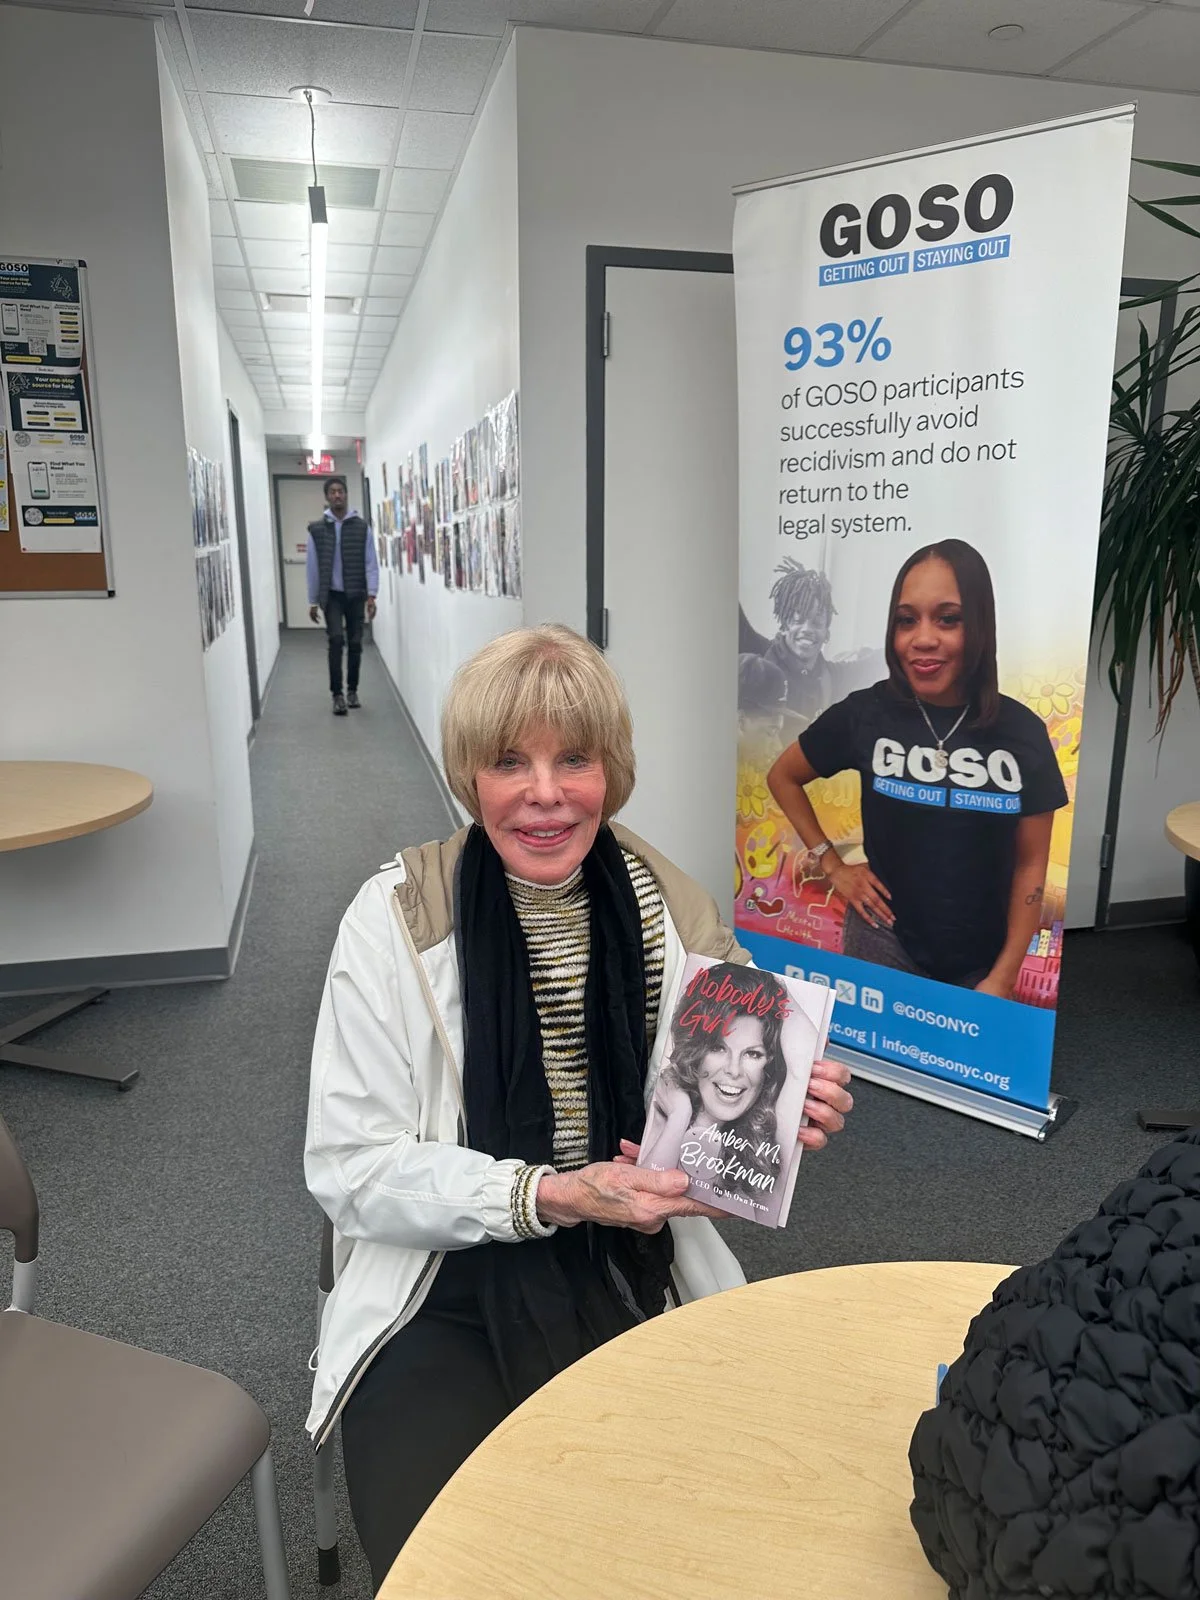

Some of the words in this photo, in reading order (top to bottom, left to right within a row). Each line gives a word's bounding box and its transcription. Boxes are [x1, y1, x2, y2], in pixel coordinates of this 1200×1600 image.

[819, 173, 1014, 259] GOSO
[823, 262, 875, 283] GETTING
[879, 256, 906, 274] OUT
[917, 245, 974, 268] STAYING
[978, 239, 1007, 257] OUT
[783, 316, 892, 371] 93%
[781, 387, 801, 410] of
[805, 380, 877, 408] GOSO
[883, 368, 1025, 406] participants
[780, 411, 911, 442] successfully
[916, 404, 979, 431] avoid
[780, 448, 885, 473] recidivism
[891, 442, 934, 467] and
[941, 441, 970, 463] do
[977, 439, 1017, 462] not
[779, 483, 842, 504] return
[848, 483, 868, 502] to
[873, 479, 909, 500] the
[778, 514, 825, 540] legal
[831, 514, 912, 538] system.
[872, 737, 1023, 793] GOSO
[875, 777, 915, 798] GETTING
[918, 788, 942, 802] OUT
[955, 792, 1002, 810] STAYING
[686, 967, 794, 1020] Nobody's
[679, 1000, 738, 1038] Girl
[893, 1001, 980, 1038] @GOSONYC
[882, 1035, 1011, 1091] info@gosonyc.org
[698, 1122, 754, 1152] Amber
[755, 1140, 780, 1165] M.
[680, 1141, 776, 1194] Brookman
[749, 1199, 769, 1212] Terms
